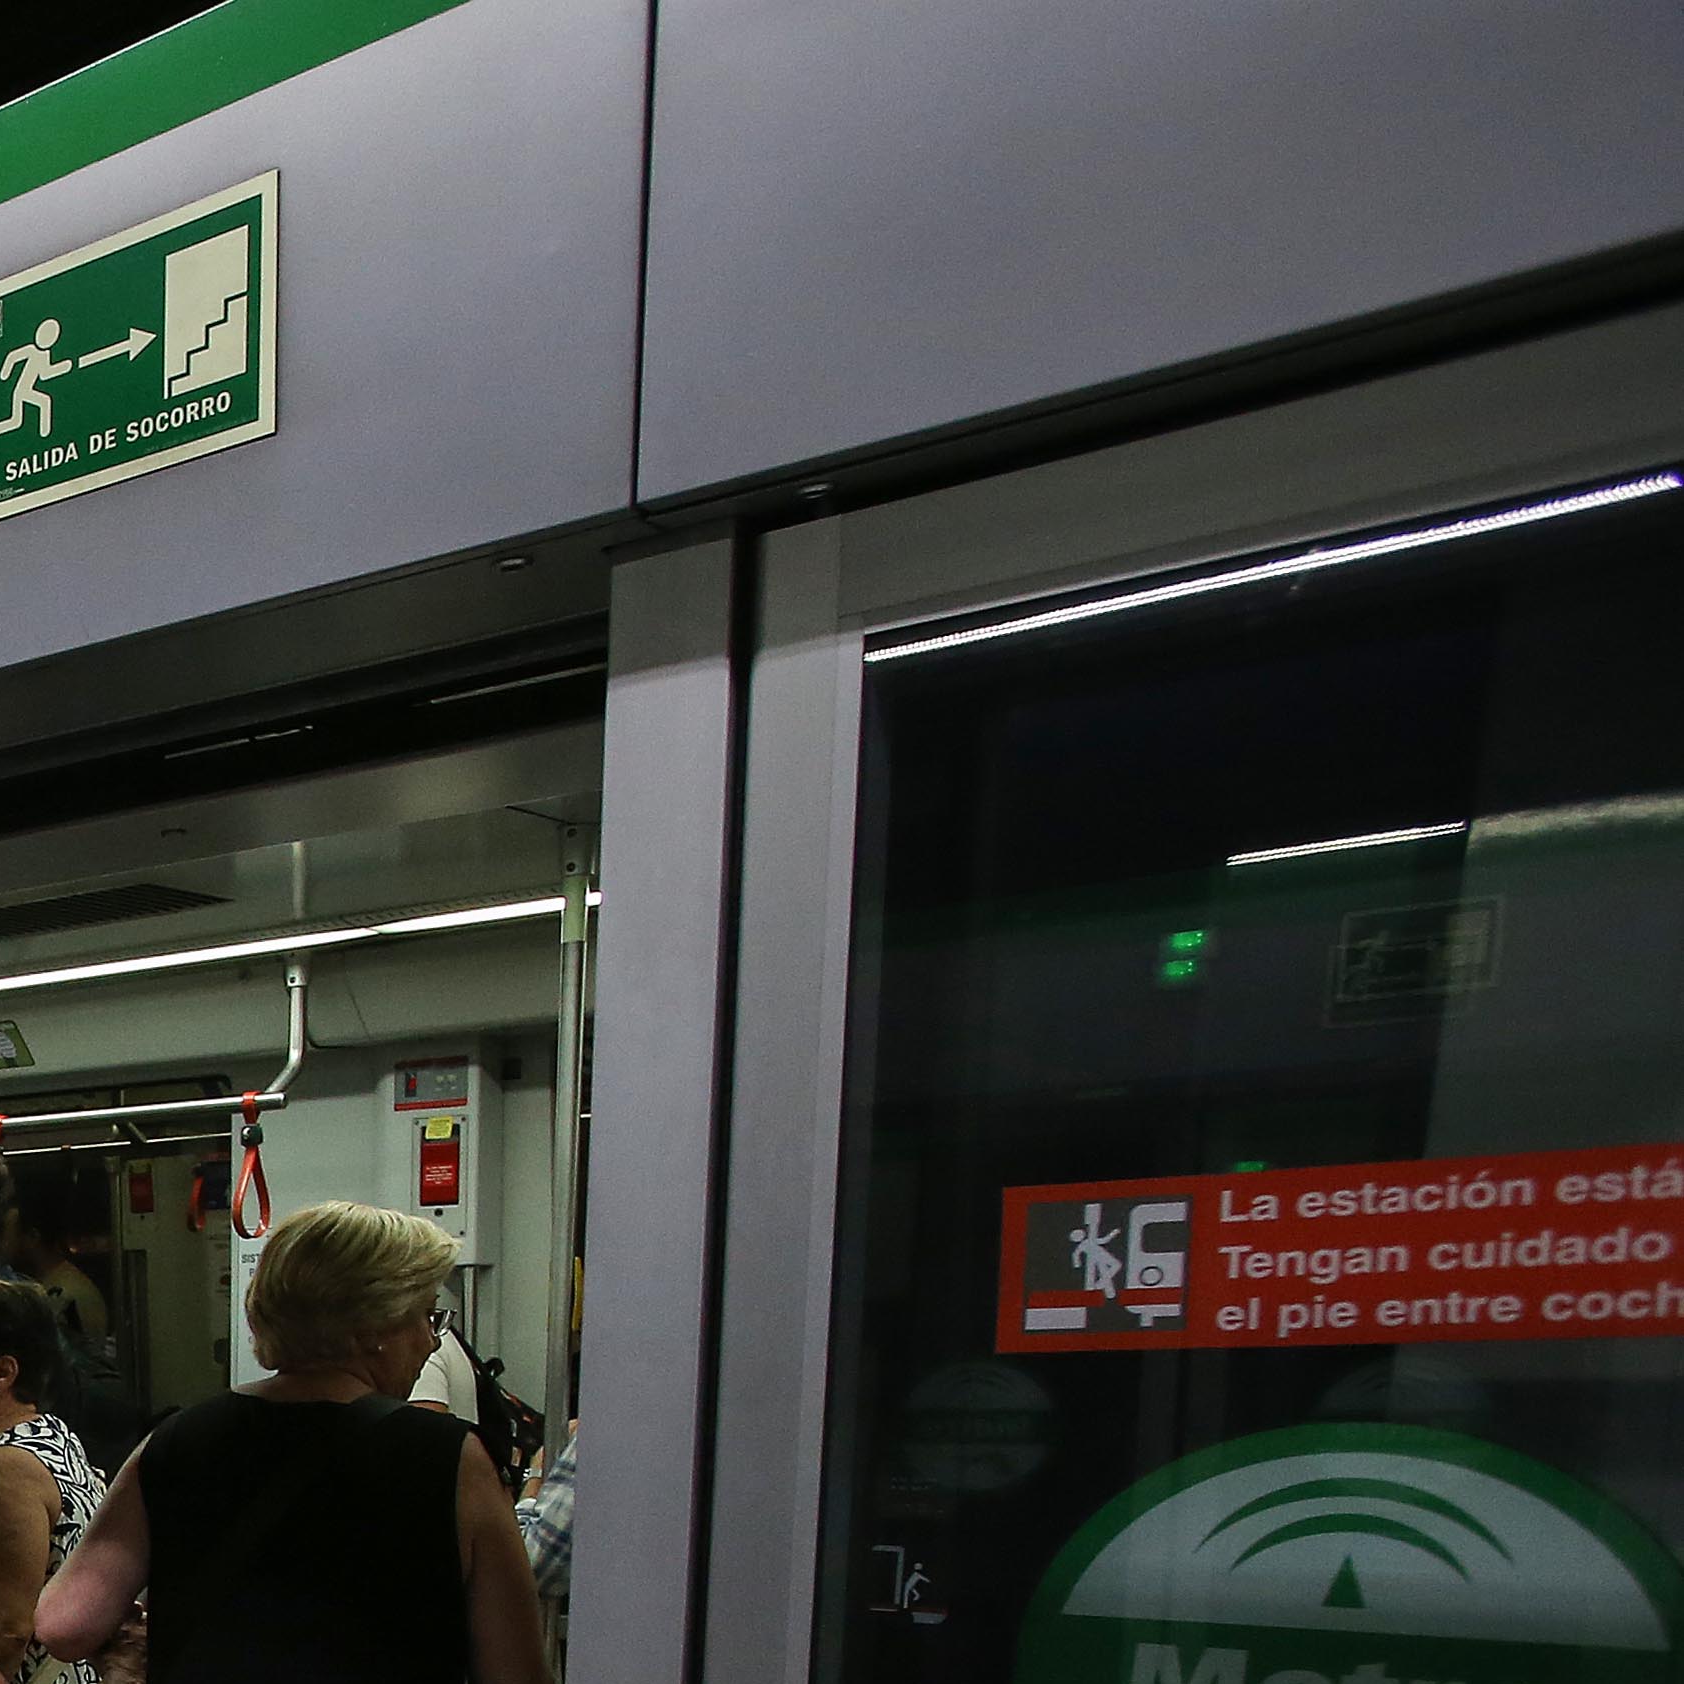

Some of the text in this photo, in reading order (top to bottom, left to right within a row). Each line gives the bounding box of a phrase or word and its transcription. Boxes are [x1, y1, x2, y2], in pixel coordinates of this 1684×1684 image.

[5, 441, 79, 481] SALIDA
[89, 428, 117, 454] DE
[126, 391, 232, 443] SOCORRO
[1219, 1157, 1684, 1223] La estación está
[1217, 1226, 1673, 1286] Tengan cuidado
[1215, 1296, 1261, 1332] el
[1277, 1294, 1361, 1339] pie
[1374, 1291, 1524, 1329] entre
